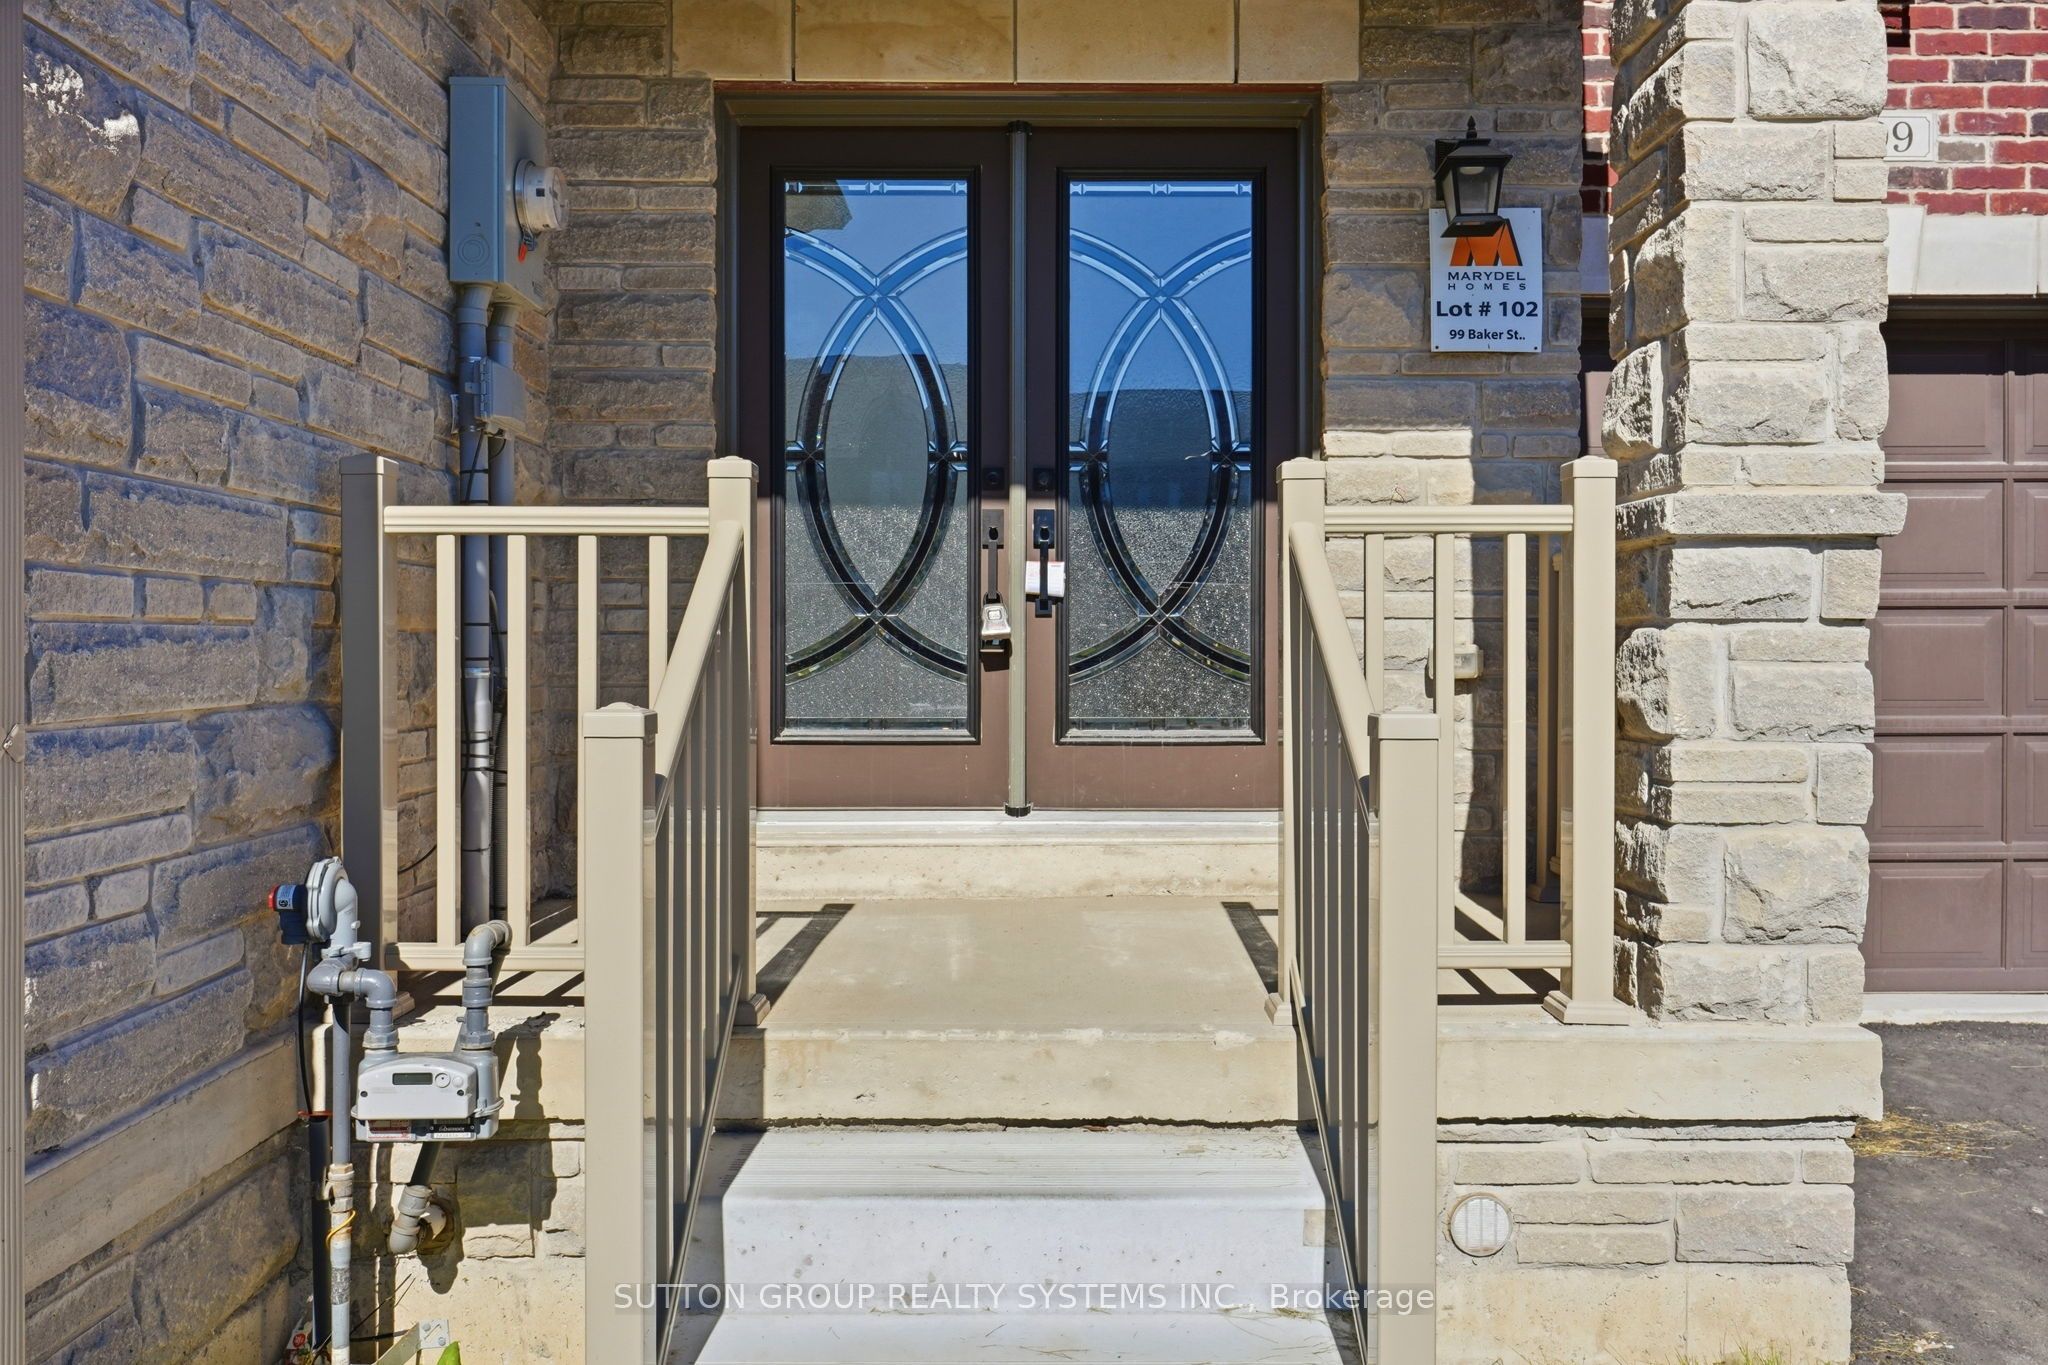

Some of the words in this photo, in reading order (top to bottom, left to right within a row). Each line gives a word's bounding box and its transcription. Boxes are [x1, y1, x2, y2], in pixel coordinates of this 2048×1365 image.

[1886, 121, 1913, 152] 9
[1448, 271, 1526, 281] MARYDEL
[1436, 301, 1472, 317] Lot
[1479, 301, 1491, 317] #
[1499, 301, 1538, 317] 102
[1449, 329, 1465, 340] 99
[1468, 329, 1504, 340] Baker
